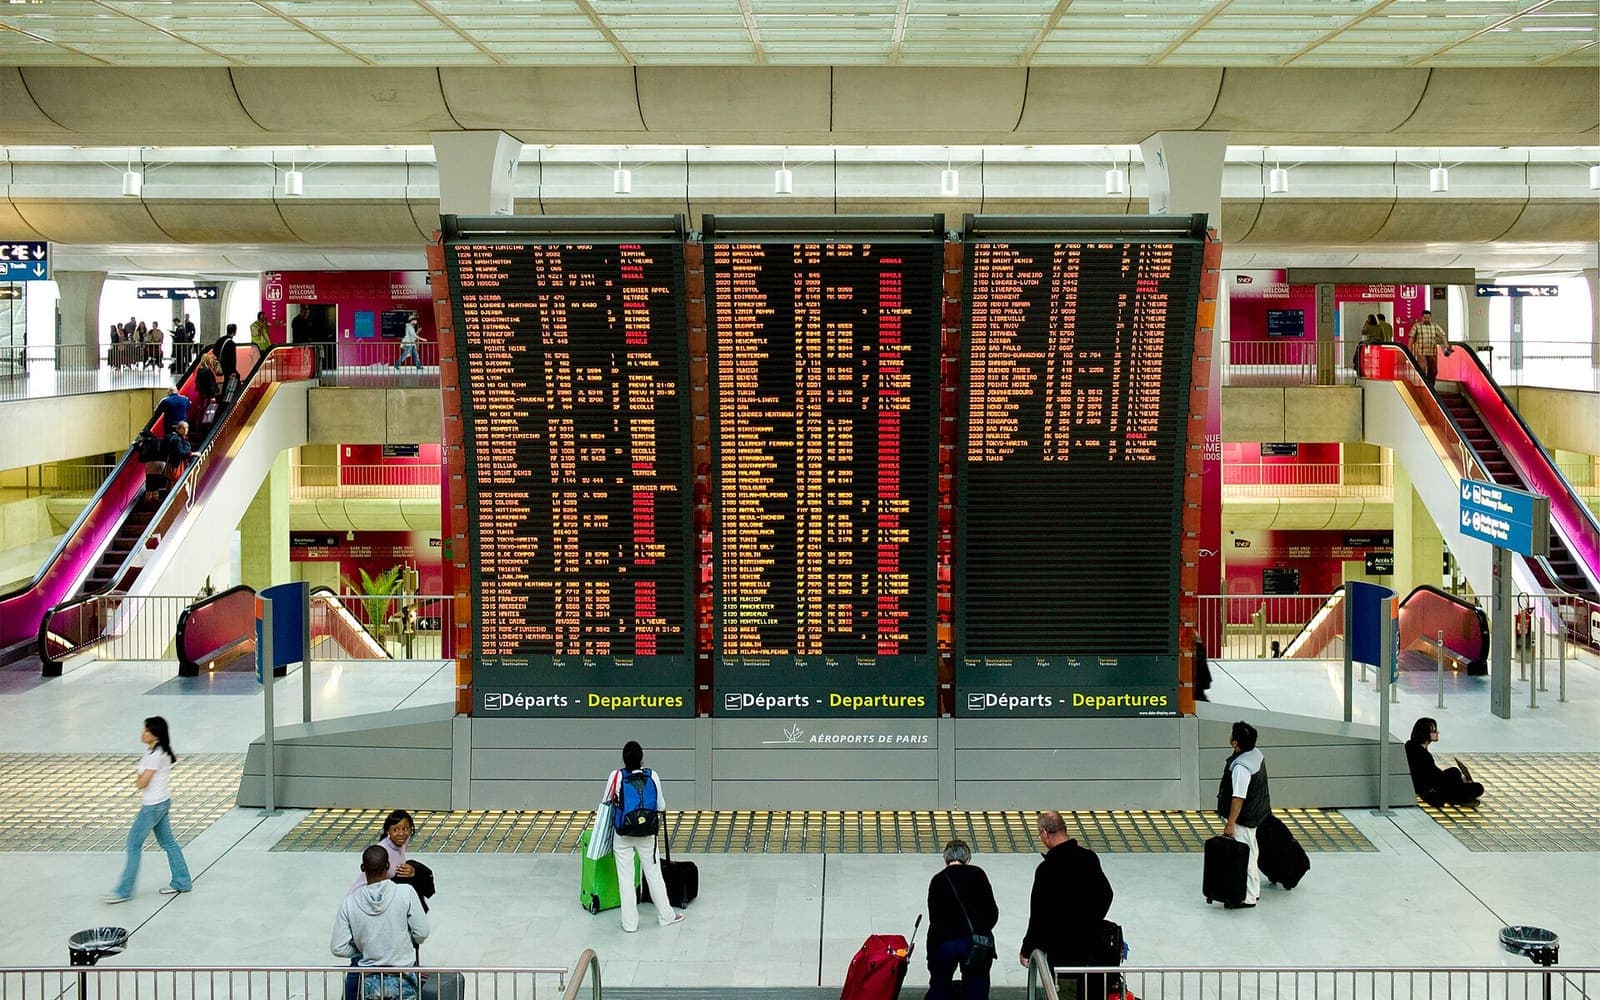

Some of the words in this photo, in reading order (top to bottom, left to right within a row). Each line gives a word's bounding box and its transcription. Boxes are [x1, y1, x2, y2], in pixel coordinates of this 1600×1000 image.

[503, 693, 567, 710] Départs
[589, 694, 683, 710] Departures
[743, 693, 809, 710] Départs
[830, 694, 924, 710] Departures
[986, 693, 1052, 710] Départs
[1073, 694, 1167, 710] Departures
[810, 733, 874, 743] AÉROPORTS
[878, 735, 893, 743] DE
[896, 735, 928, 743] PARIS
